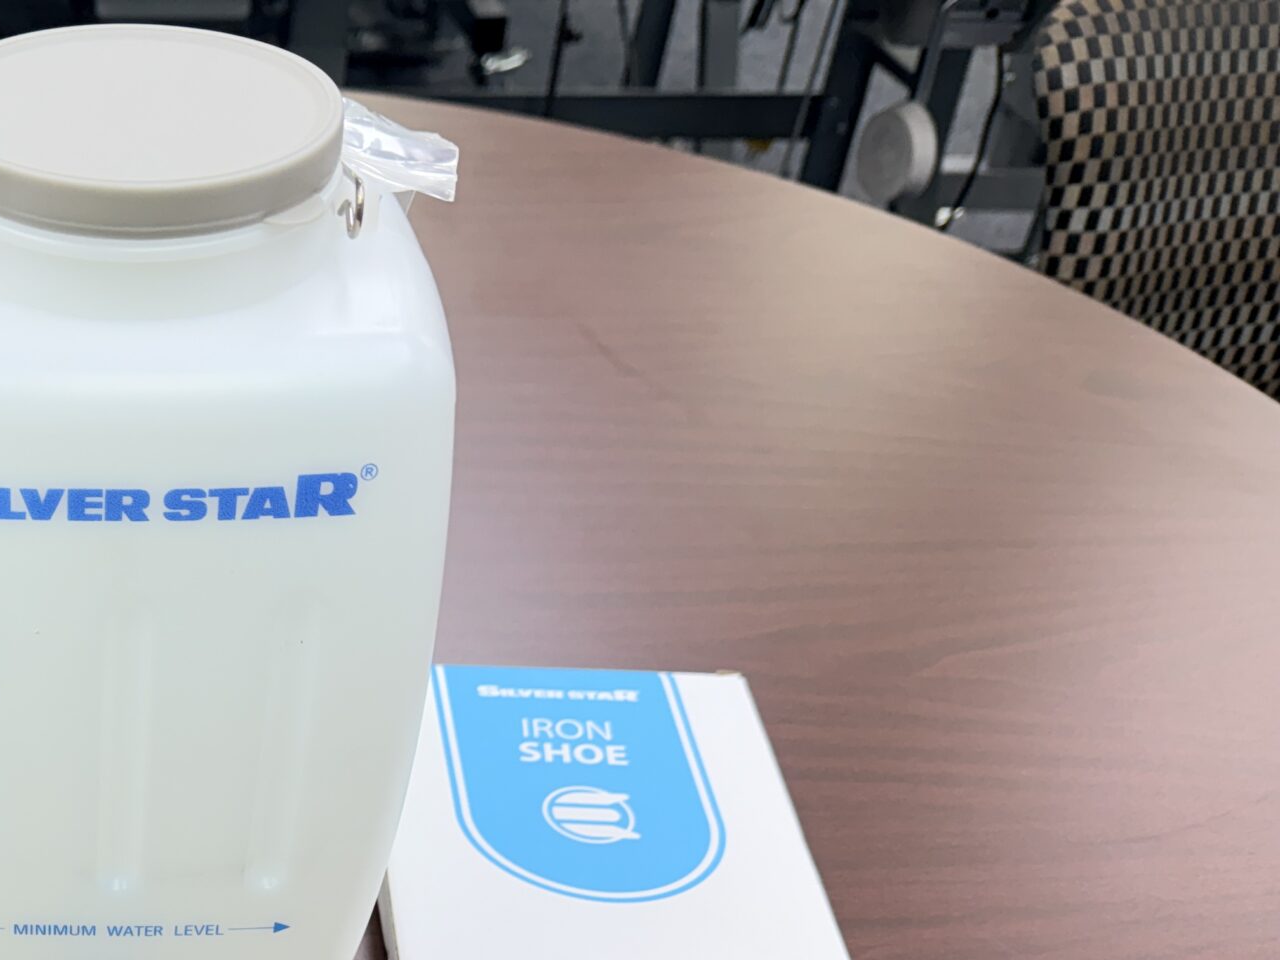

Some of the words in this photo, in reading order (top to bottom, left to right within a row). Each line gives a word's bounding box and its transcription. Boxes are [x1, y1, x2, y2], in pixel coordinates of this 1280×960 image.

[163, 472, 359, 521] STAR
[477, 685, 564, 700] SILVER
[567, 689, 640, 702] STAR
[521, 717, 613, 741] IRON
[518, 742, 629, 766] SHOE
[13, 923, 97, 937] MINIMUM
[107, 925, 163, 937] WATER
[174, 924, 224, 936] LEVEL
